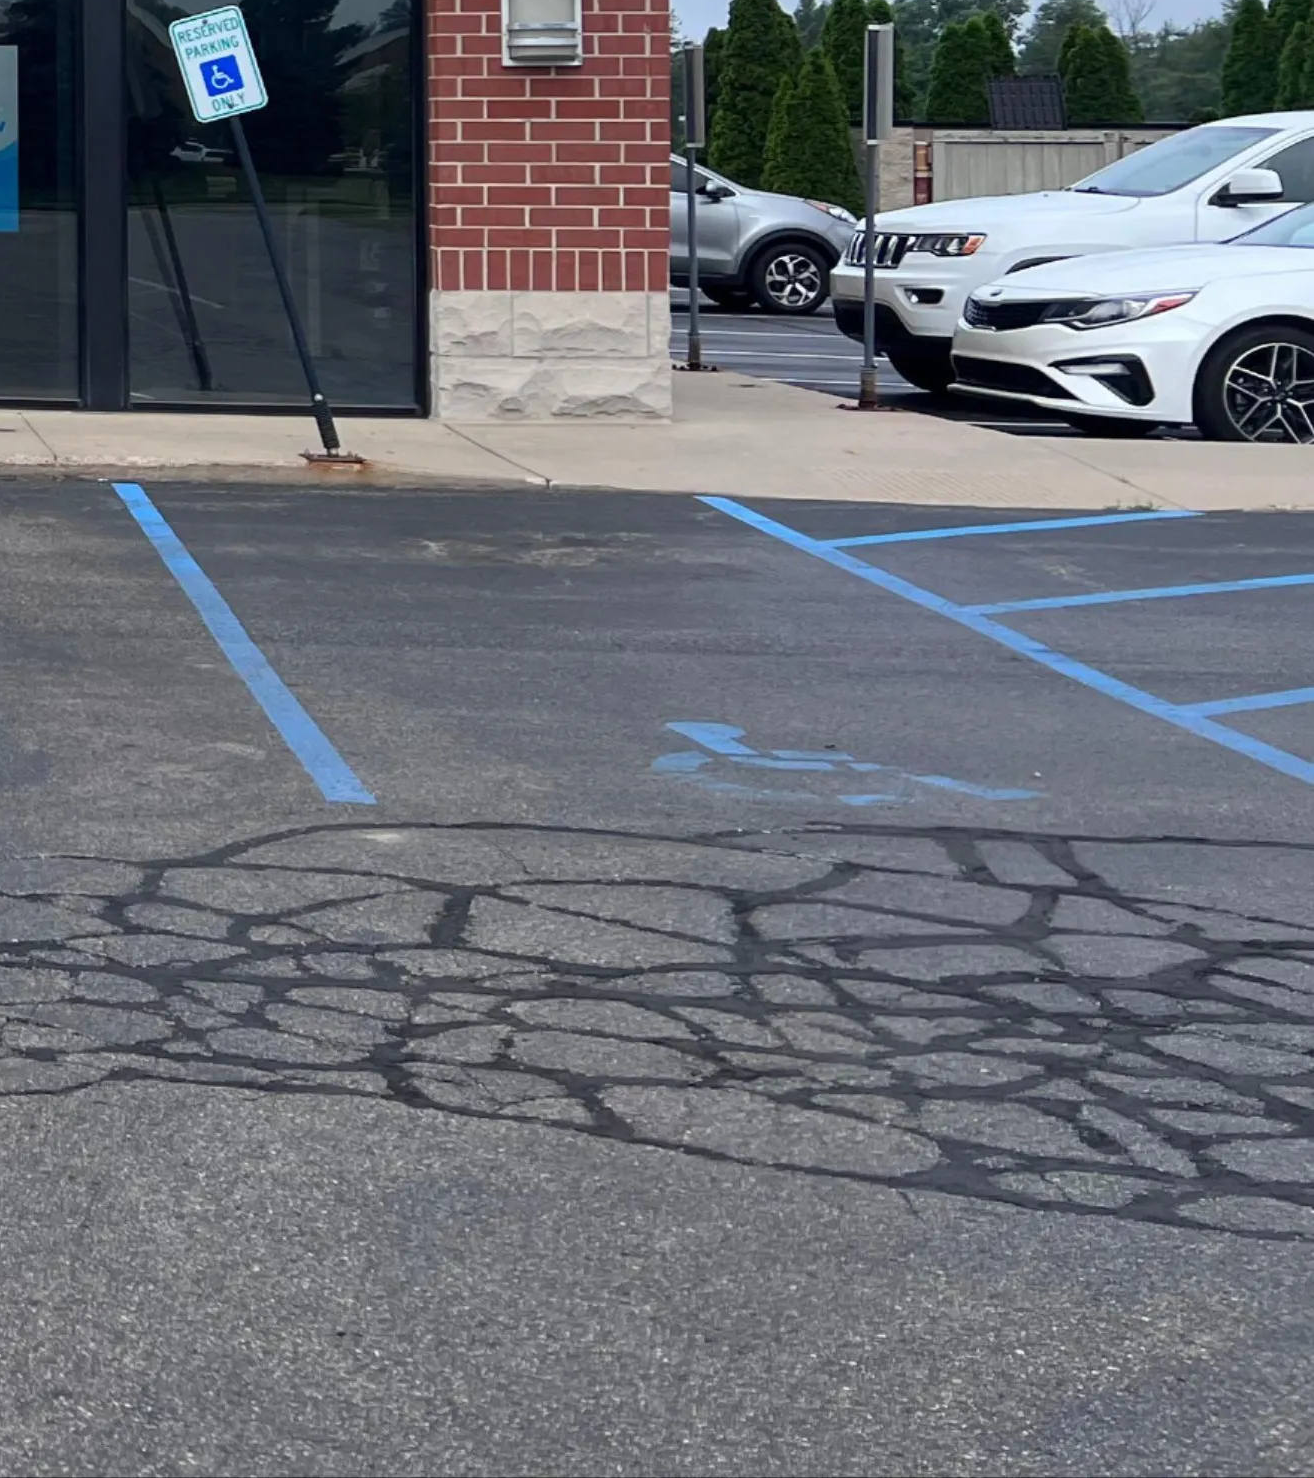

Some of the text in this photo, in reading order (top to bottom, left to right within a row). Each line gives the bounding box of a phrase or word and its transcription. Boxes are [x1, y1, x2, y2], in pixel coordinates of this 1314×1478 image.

[177, 16, 240, 44] RESERVED
[184, 35, 240, 60] PARKING
[211, 92, 246, 113] ONLY
